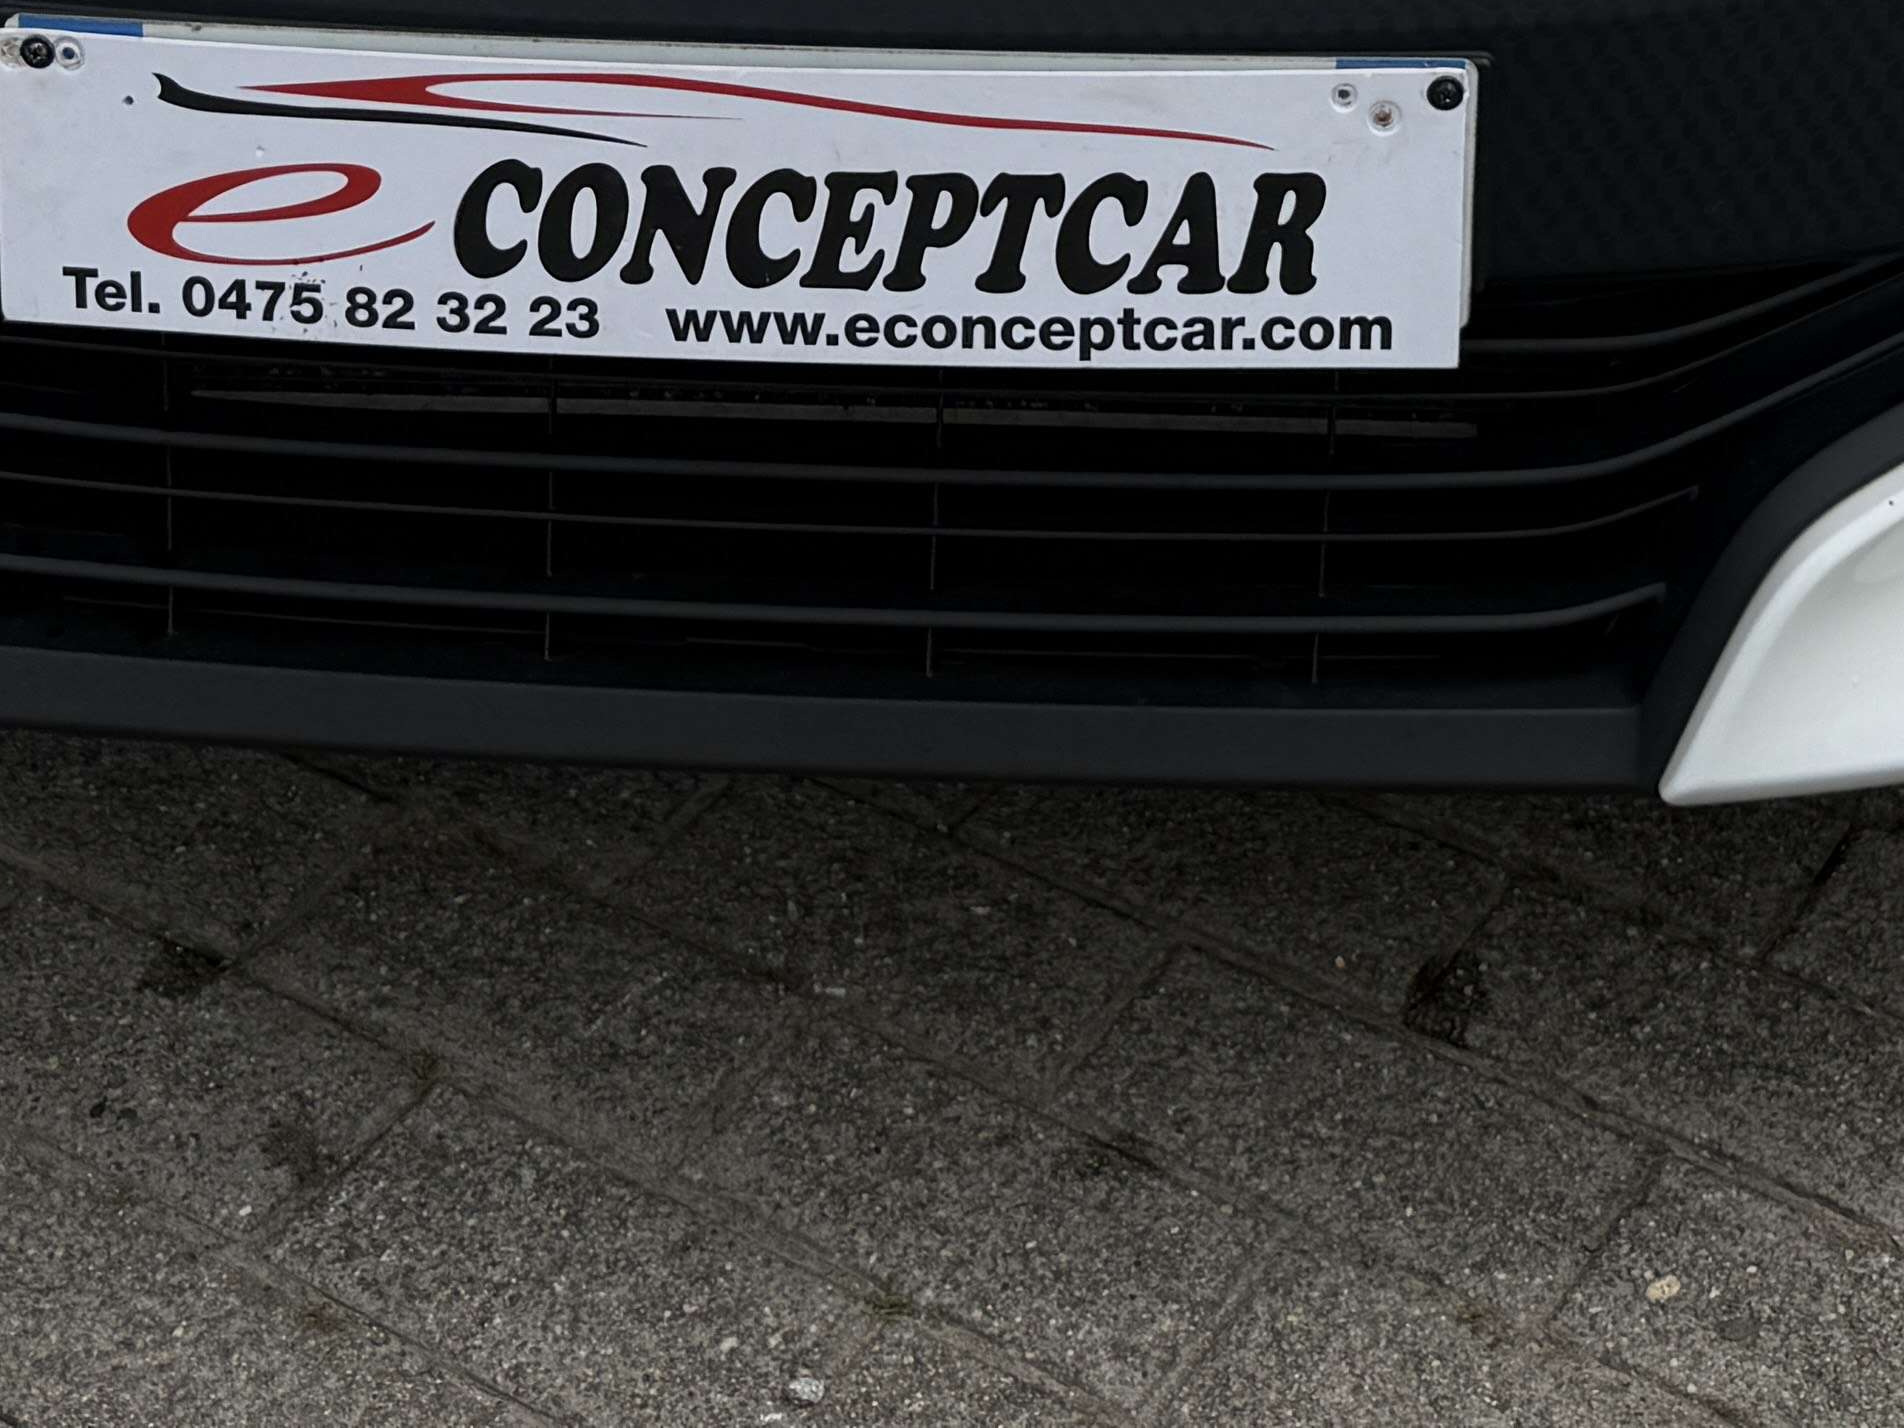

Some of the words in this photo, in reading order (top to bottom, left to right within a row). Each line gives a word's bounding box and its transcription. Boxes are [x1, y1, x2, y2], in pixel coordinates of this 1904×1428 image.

[453, 158, 1327, 296] CONCEPTCAR
[62, 266, 162, 314] Tel.
[181, 275, 324, 324] 0475
[344, 287, 415, 331] 82
[436, 291, 507, 335] 32
[528, 296, 600, 338] 23
[665, 307, 1393, 361] www.econceptcar.com
